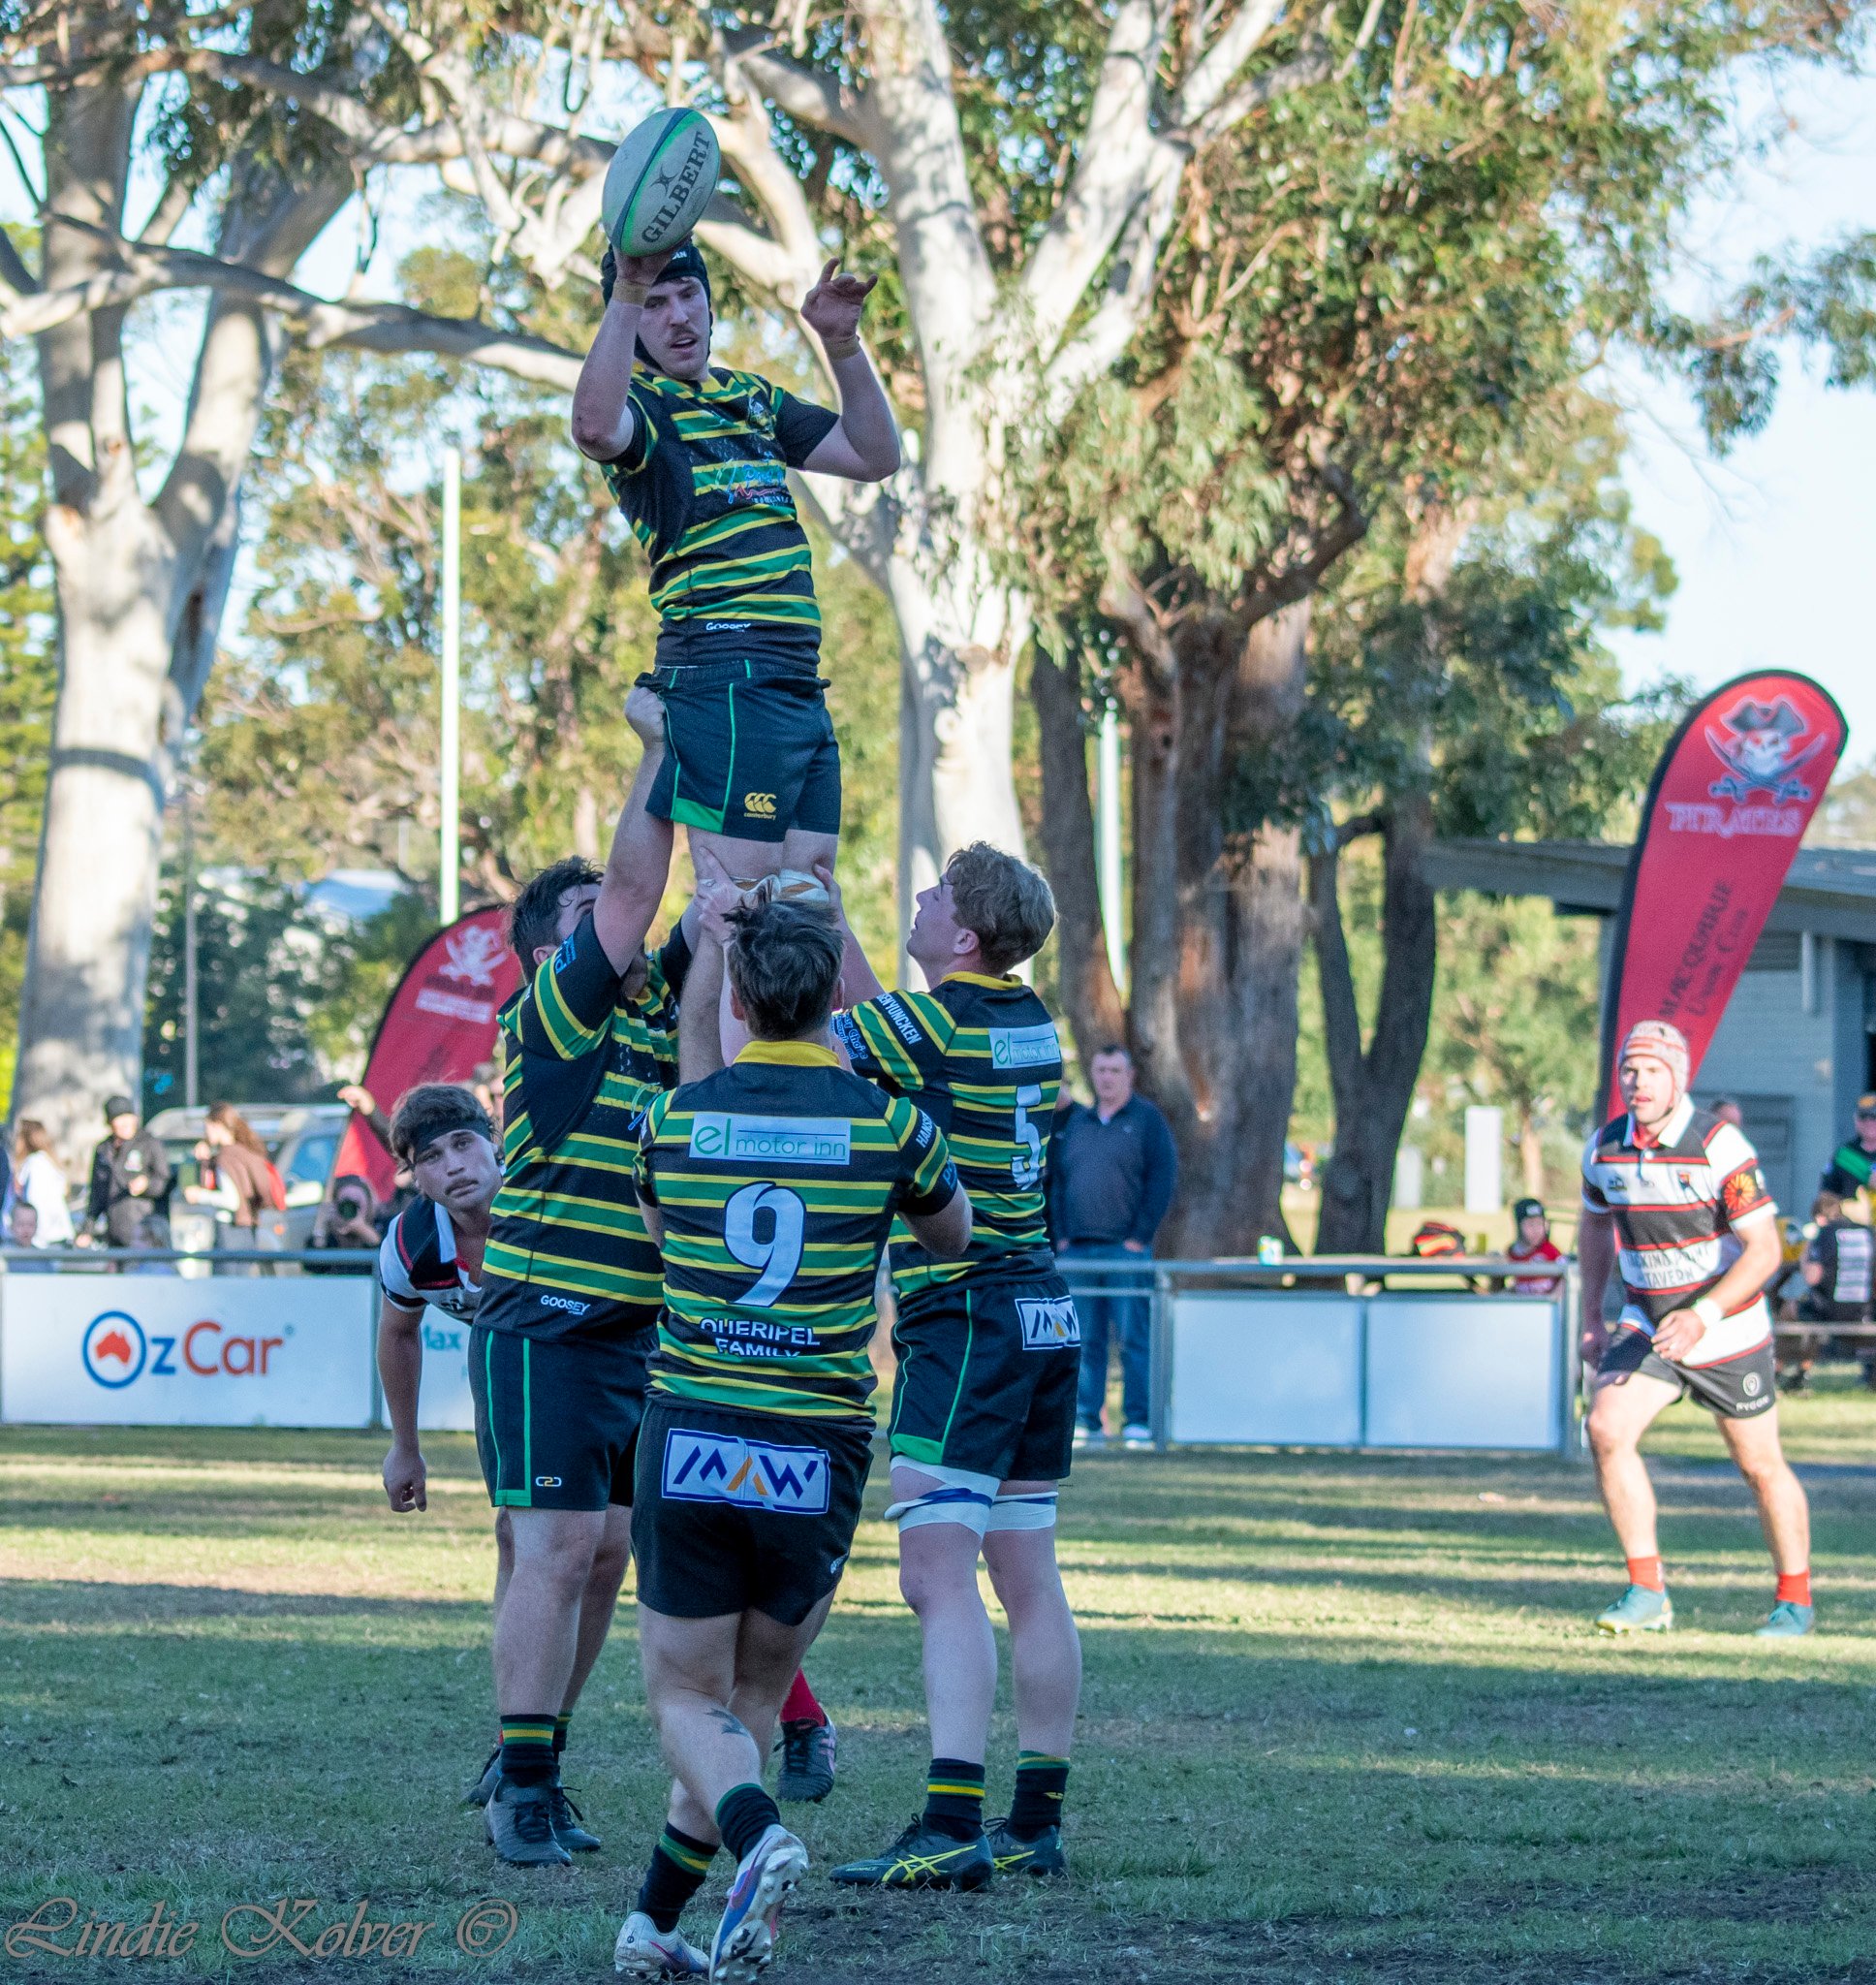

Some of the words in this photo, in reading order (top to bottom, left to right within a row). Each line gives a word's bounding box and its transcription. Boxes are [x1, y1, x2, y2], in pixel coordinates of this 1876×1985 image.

[641, 131, 710, 243] GILBERT
[743, 810, 776, 821] canterbury
[994, 1031, 1013, 1065] el
[695, 1118, 732, 1156] el
[735, 1137, 806, 1155] motor
[814, 1136, 846, 1156] inn
[1012, 1084, 1042, 1190] 5
[724, 1181, 807, 1308] 9
[540, 1294, 591, 1312] GOOSEY
